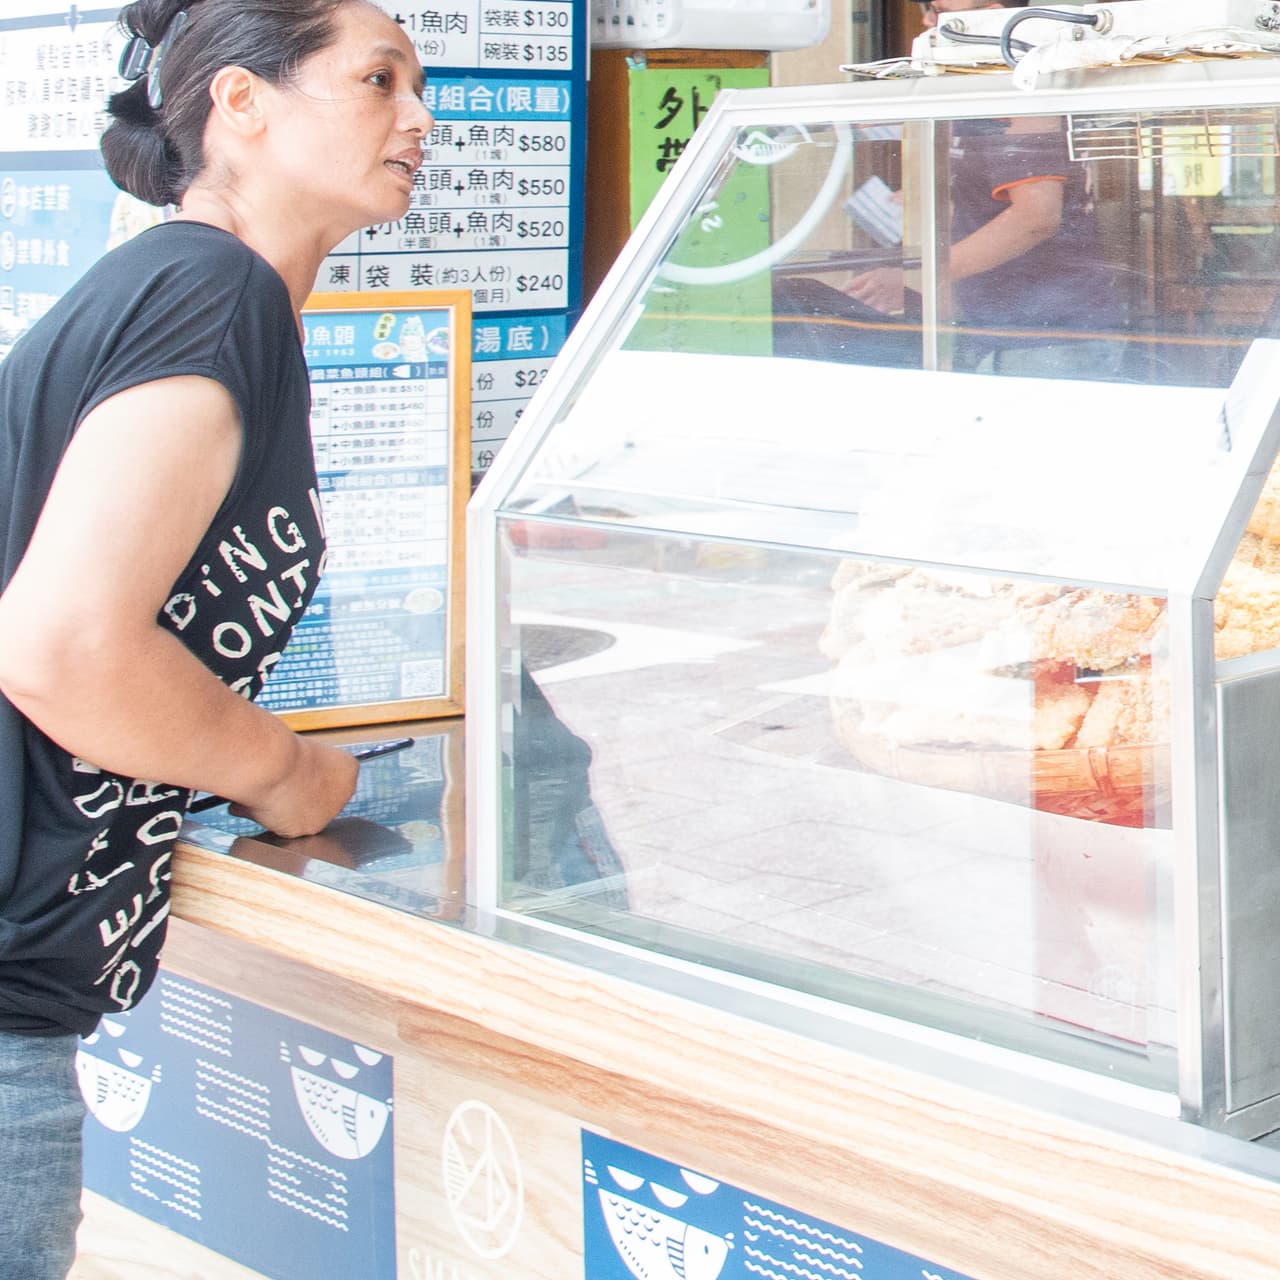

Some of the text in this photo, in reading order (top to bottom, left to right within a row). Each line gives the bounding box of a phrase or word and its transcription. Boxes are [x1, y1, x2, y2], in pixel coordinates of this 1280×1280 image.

[484, 9, 569, 30] 袋裝 $130
[483, 41, 568, 62] 碗裝 $135
[518, 135, 566, 152] $580
[517, 178, 565, 197] $550
[516, 220, 565, 239] $520
[516, 274, 564, 292] $240
[304, 325, 355, 346] 魚頭
